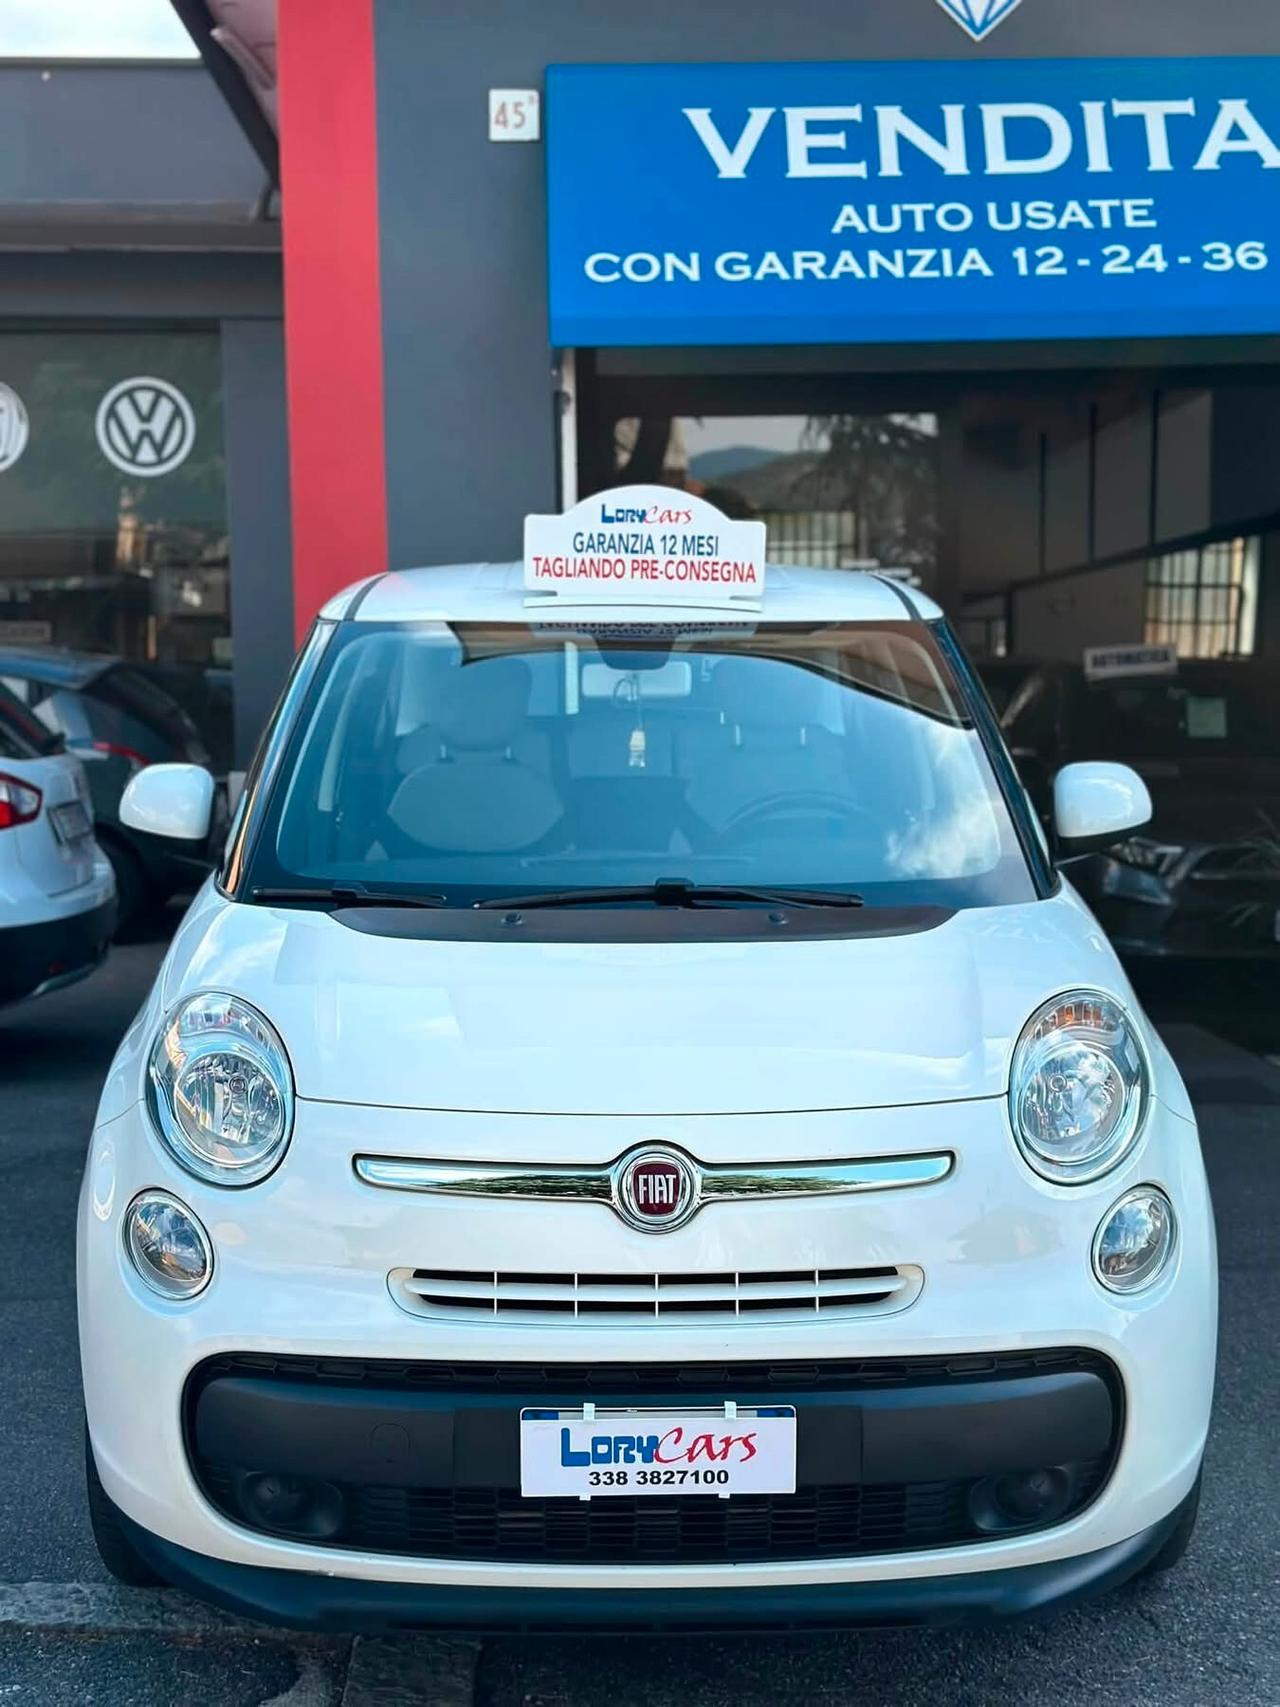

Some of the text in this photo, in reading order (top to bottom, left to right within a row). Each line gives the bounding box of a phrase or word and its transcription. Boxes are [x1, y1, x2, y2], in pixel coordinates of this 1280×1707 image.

[683, 98, 1280, 180] VENDITA
[832, 197, 1157, 235] AUTO USATE
[584, 252, 701, 284] CON
[714, 247, 994, 281] GARANZIA
[1012, 245, 1068, 276] 12
[1102, 243, 1167, 275] 24
[1202, 240, 1268, 273] 36
[572, 531, 720, 557] GARANZIA 12 MESI
[532, 556, 757, 584] TAGLIANDO PRE-CONSEGNA
[638, 1174, 677, 1205] FIAT
[588, 1469, 730, 1486] 338 3827100
